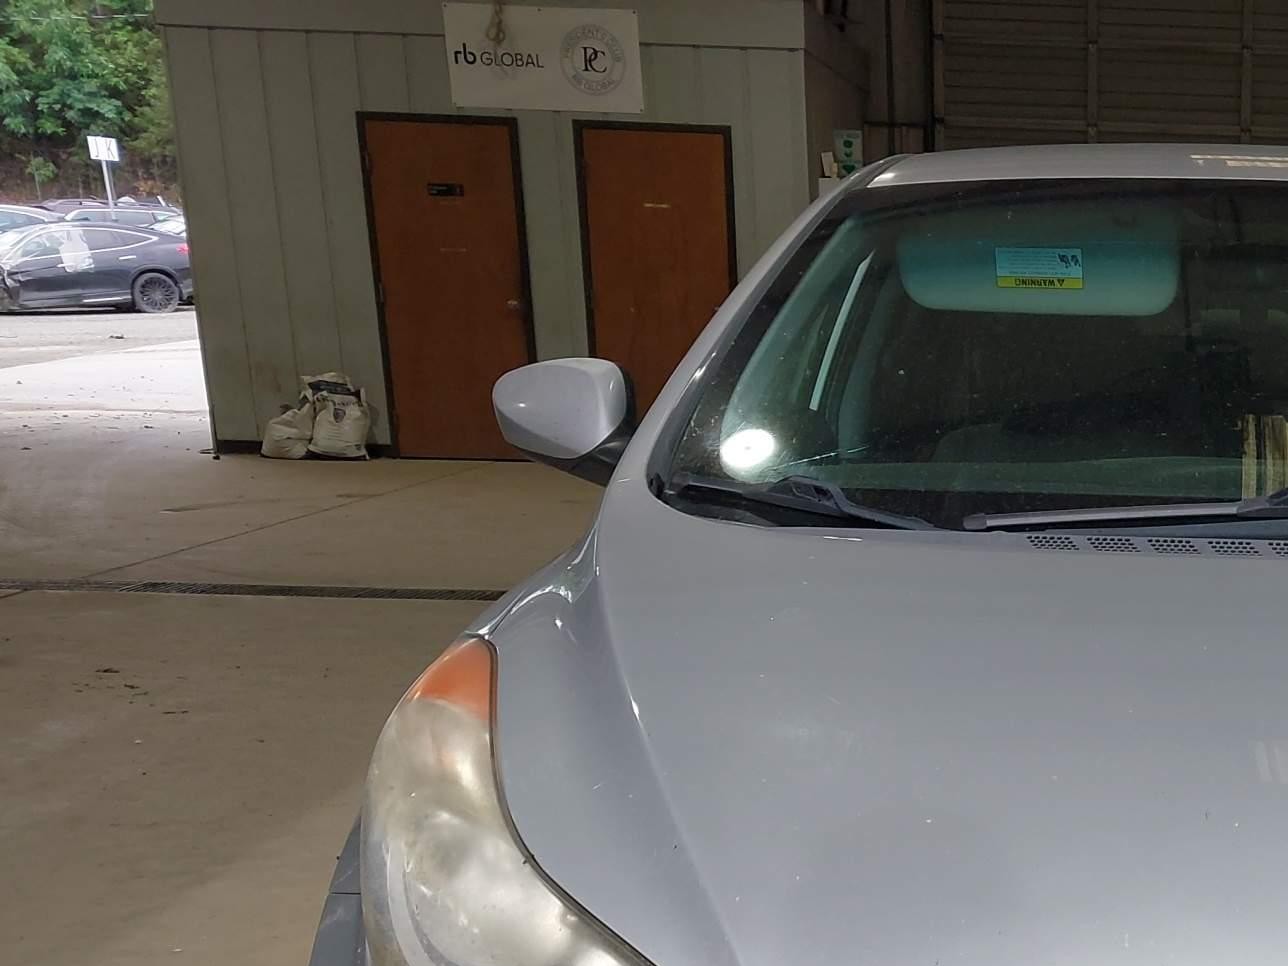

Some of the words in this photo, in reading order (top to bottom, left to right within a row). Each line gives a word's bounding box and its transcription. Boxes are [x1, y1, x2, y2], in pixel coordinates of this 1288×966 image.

[453, 42, 477, 65] rb
[479, 51, 545, 69] GLOBAL
[1014, 278, 1056, 288] WARNING
